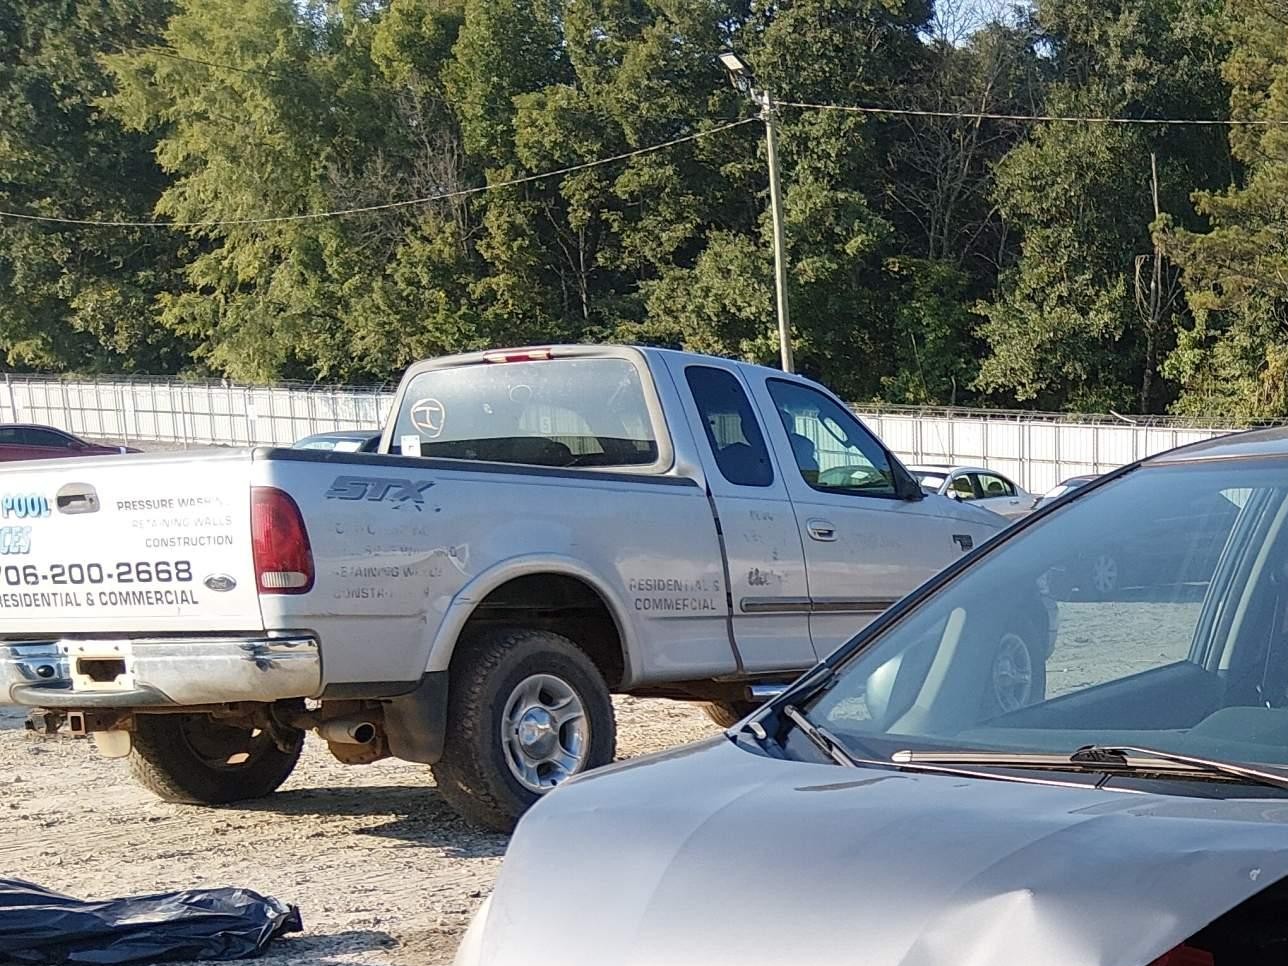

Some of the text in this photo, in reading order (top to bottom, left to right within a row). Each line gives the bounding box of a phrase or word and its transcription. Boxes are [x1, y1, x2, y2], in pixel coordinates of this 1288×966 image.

[323, 475, 436, 512] STX
[1, 494, 52, 519] POOL
[116, 498, 175, 511] PRESSURE
[145, 535, 233, 549] CONSTRUCTION
[0, 560, 193, 586] 06-200-2668
[86, 592, 95, 607] &
[98, 589, 200, 607] COMMERCIAL
